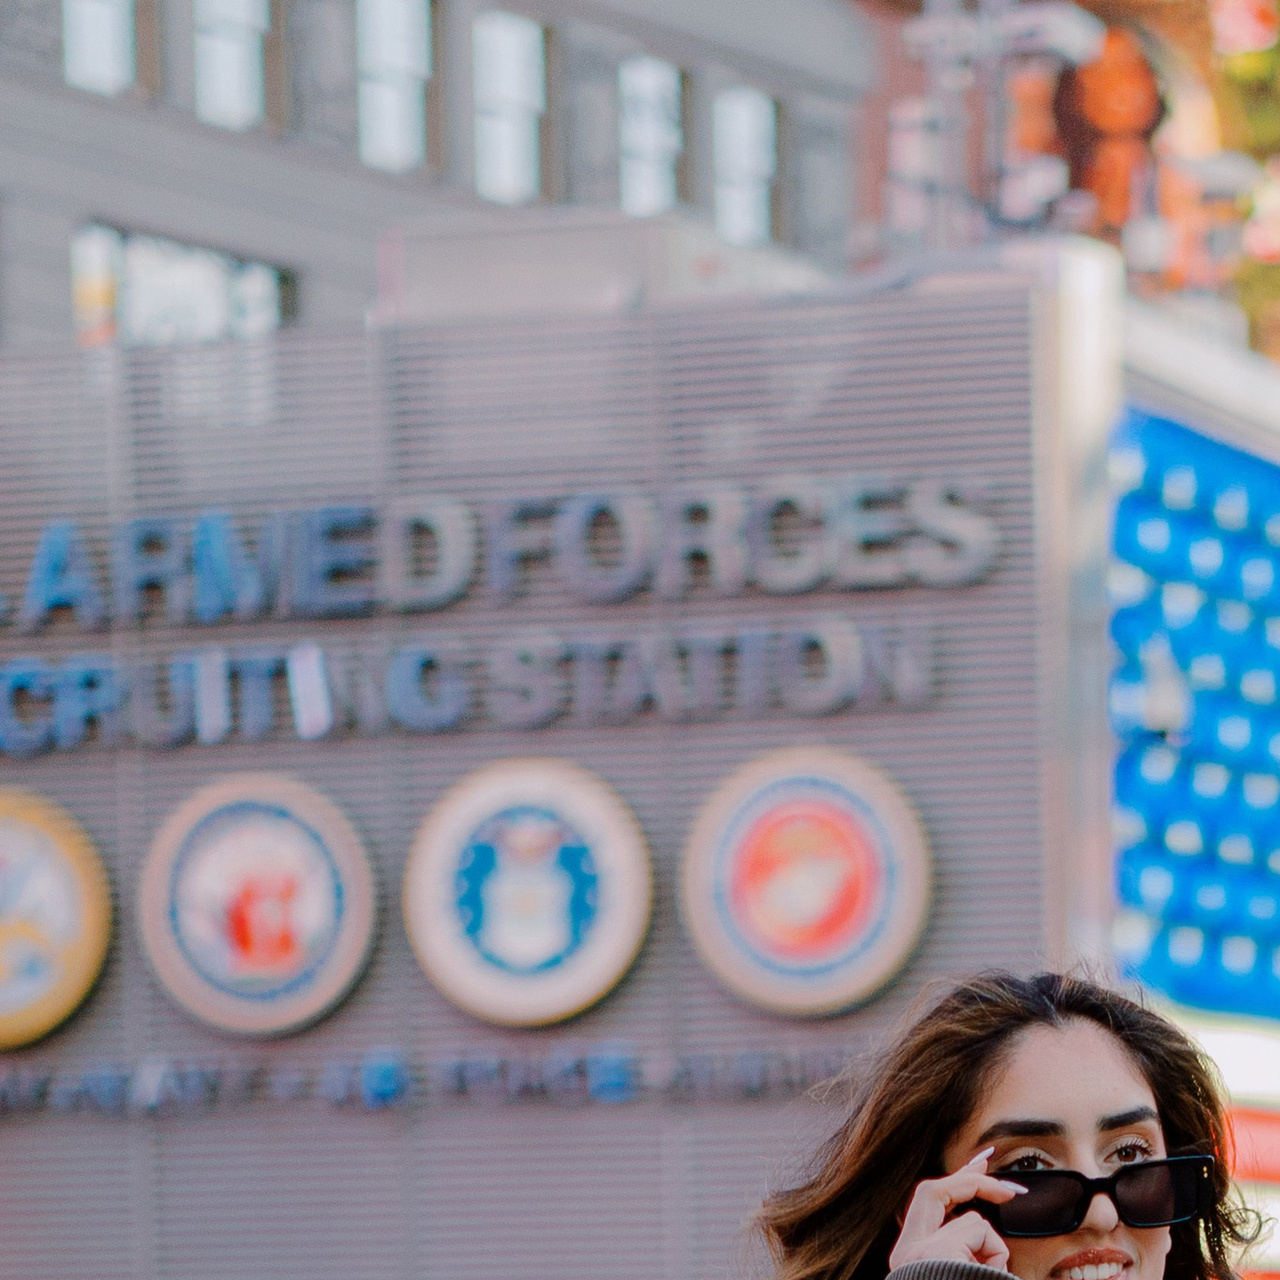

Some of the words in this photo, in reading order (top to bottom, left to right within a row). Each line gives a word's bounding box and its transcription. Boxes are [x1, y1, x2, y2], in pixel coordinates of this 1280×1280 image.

[18, 500, 480, 632] ARMED
[486, 474, 1000, 601] FORCES
[482, 618, 936, 731] STATION
